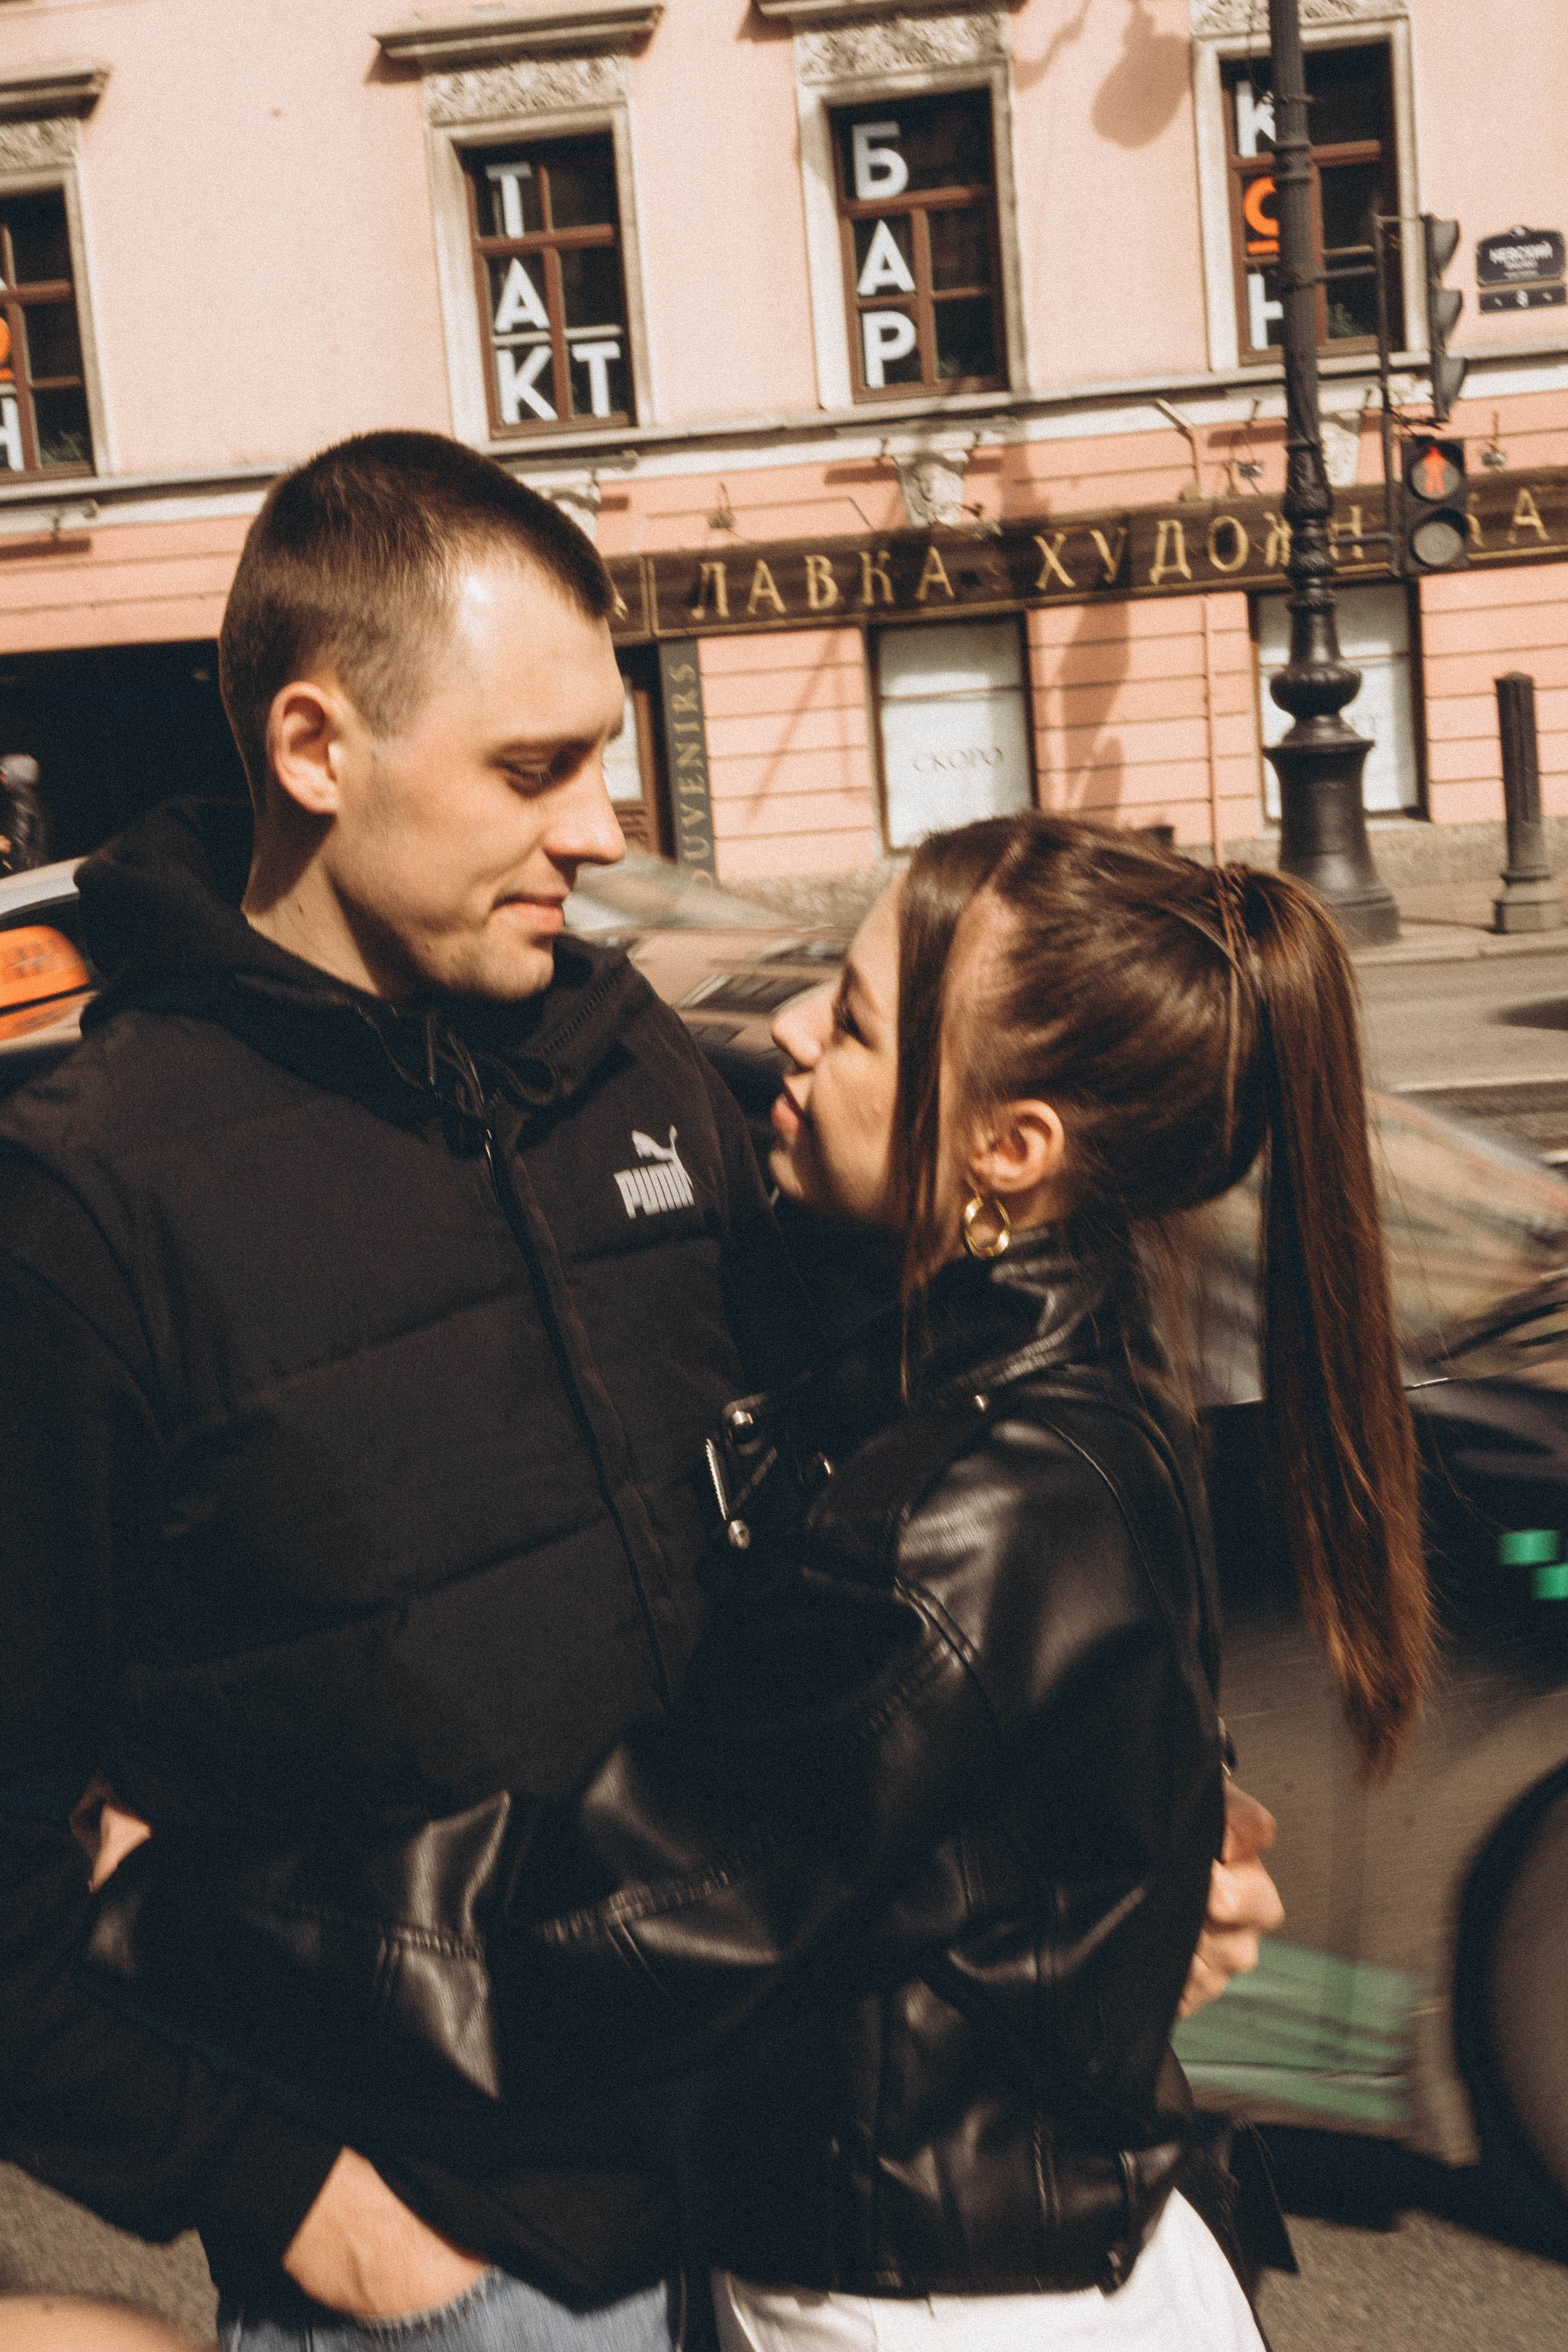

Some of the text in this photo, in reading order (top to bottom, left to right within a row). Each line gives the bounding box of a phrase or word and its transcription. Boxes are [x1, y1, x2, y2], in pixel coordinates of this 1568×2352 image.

[853, 121, 916, 388] БАР
[690, 546, 956, 620] ЛАВКА
[1033, 488, 1550, 591] ХУДОЖНА
[670, 663, 714, 886] OUVENIRS
